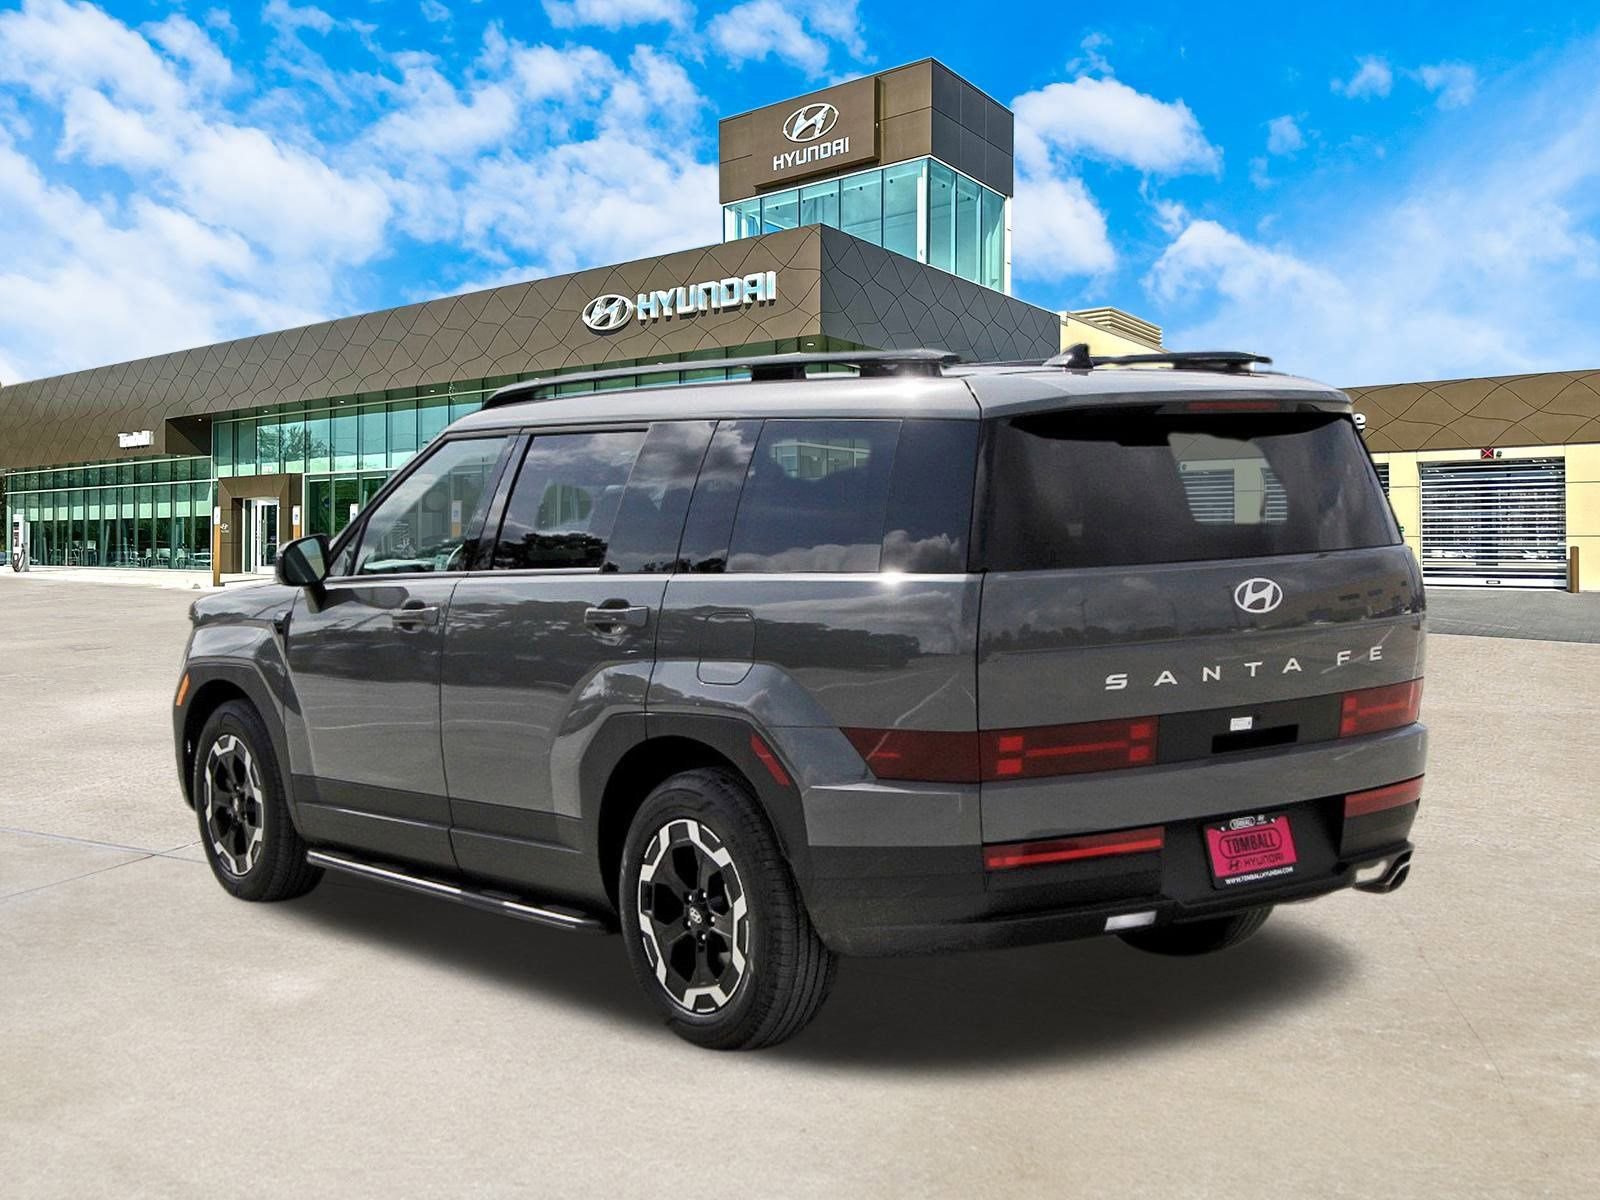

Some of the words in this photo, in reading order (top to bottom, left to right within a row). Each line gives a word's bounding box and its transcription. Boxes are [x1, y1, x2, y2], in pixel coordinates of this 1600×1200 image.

[773, 136, 850, 171] HYUNDAI
[636, 270, 777, 321] HYUNDAI
[1104, 657, 1302, 690] SANTA
[1336, 646, 1383, 666] FE
[1225, 832, 1277, 855] TOMBALL
